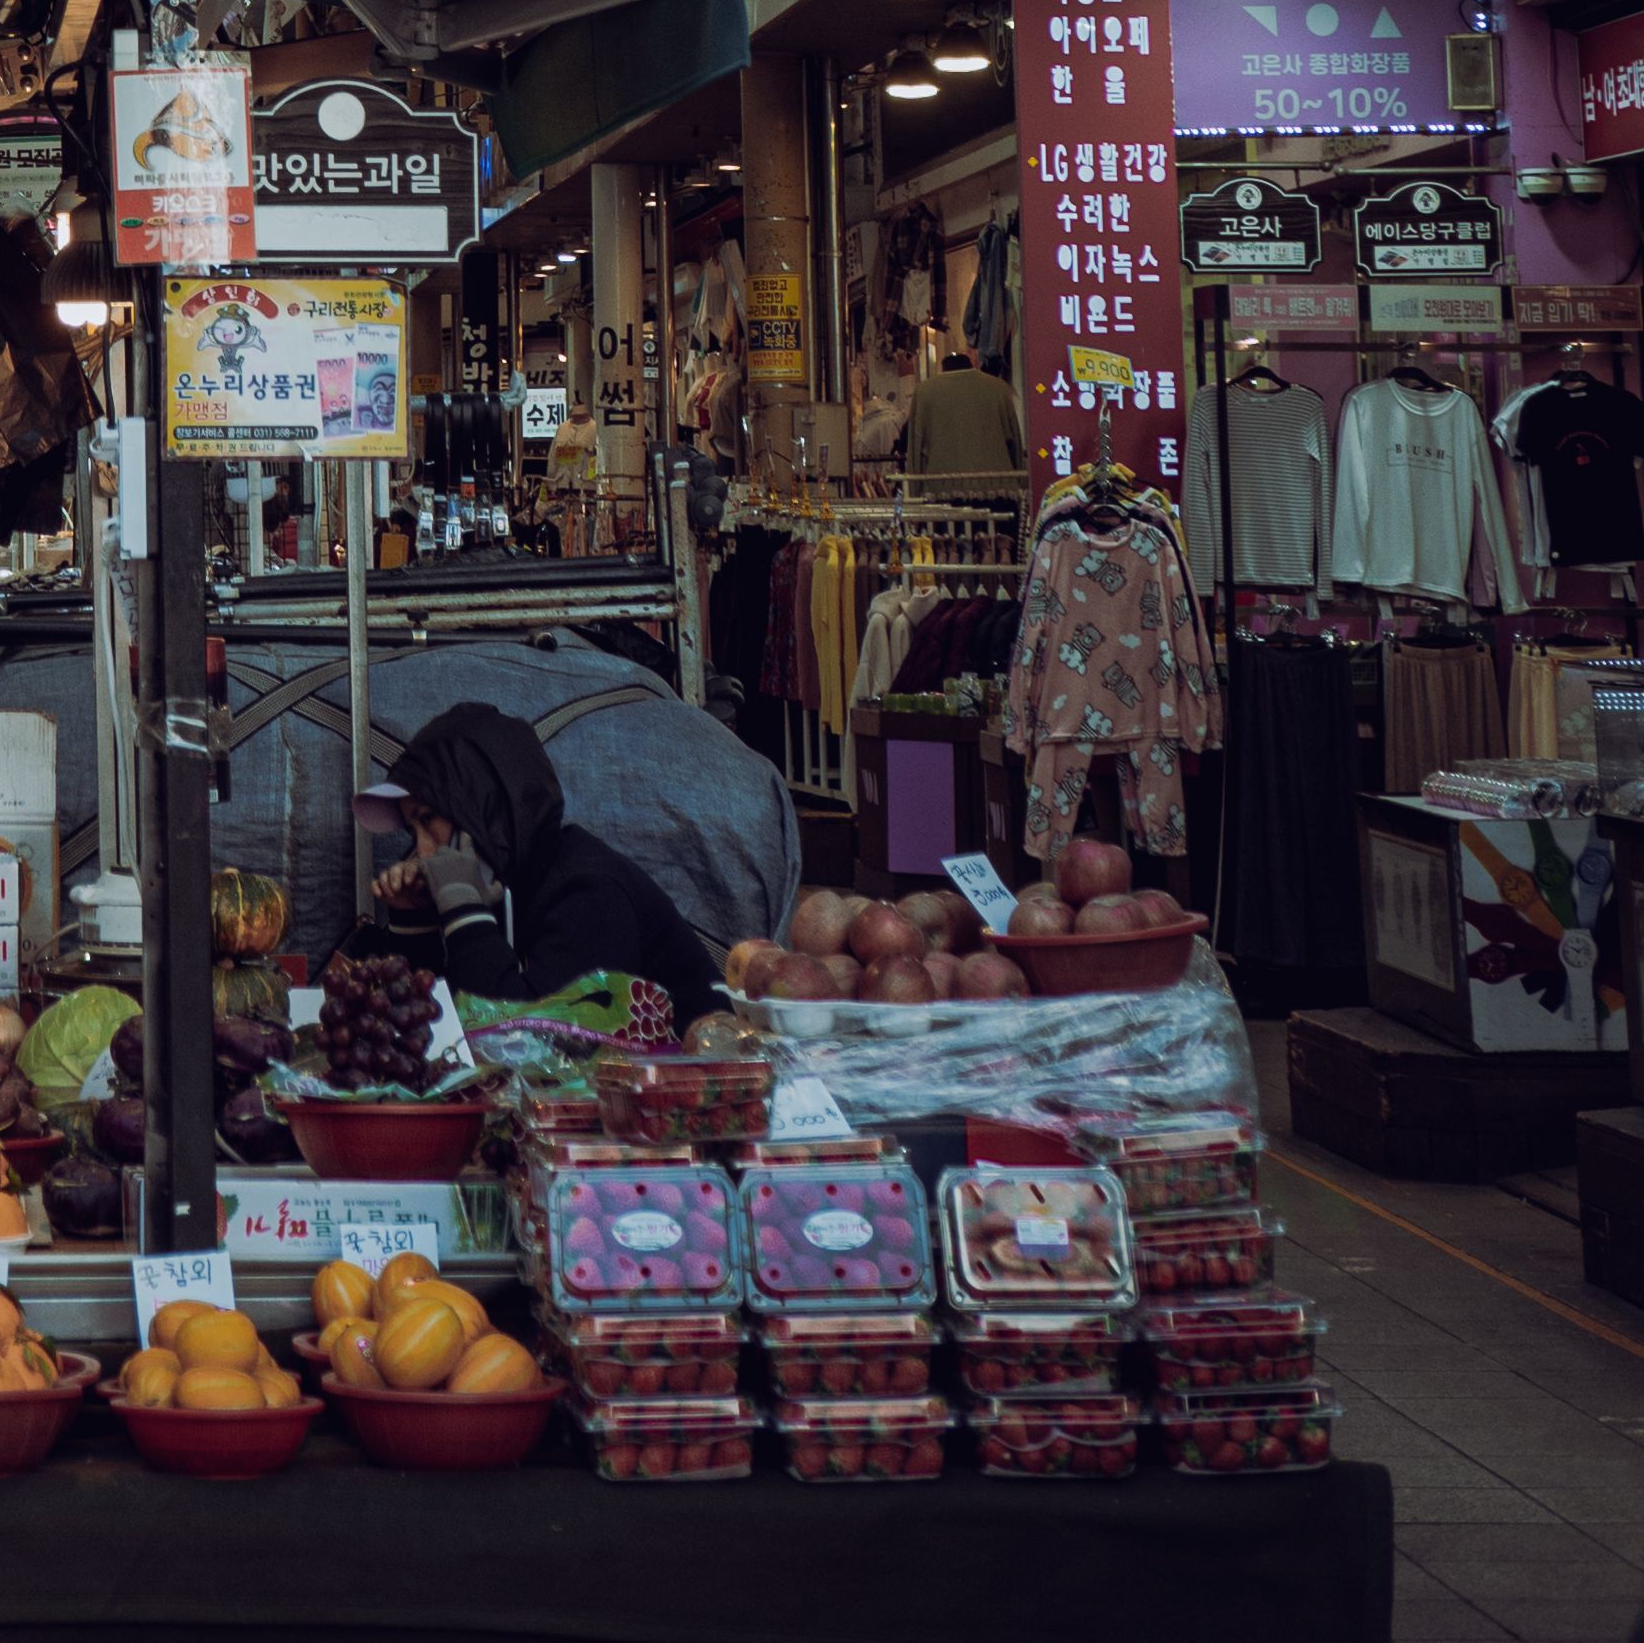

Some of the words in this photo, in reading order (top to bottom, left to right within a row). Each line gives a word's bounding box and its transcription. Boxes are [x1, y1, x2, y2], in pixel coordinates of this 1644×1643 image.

[1049, 16, 1149, 55] 아이오페
[1242, 54, 1302, 75] 고은사
[1309, 51, 1411, 75] 종합화장품
[1255, 88, 1407, 120] 50~10%
[253, 152, 442, 195] 맛있는과일
[1040, 143, 1068, 182] LG
[1075, 142, 1167, 183] 생활건강
[1056, 193, 1130, 233] 수려한
[1219, 217, 1282, 238] 고은사
[1365, 223, 1492, 241] 에이스당구클럽
[1057, 244, 1160, 283] 이자녹스
[202, 287, 261, 307] 상인회
[304, 301, 387, 319] 구리전통시장
[1059, 294, 1135, 334] 비욘드
[762, 321, 796, 335] CCTV
[763, 336, 796, 349] 녹화중
[357, 352, 389, 365] 10000
[174, 373, 316, 400] 온누리상품권
[598, 323, 636, 427] 어썸
[174, 401, 229, 421] 가맹점
[176, 427, 224, 438] 장보기서비스
